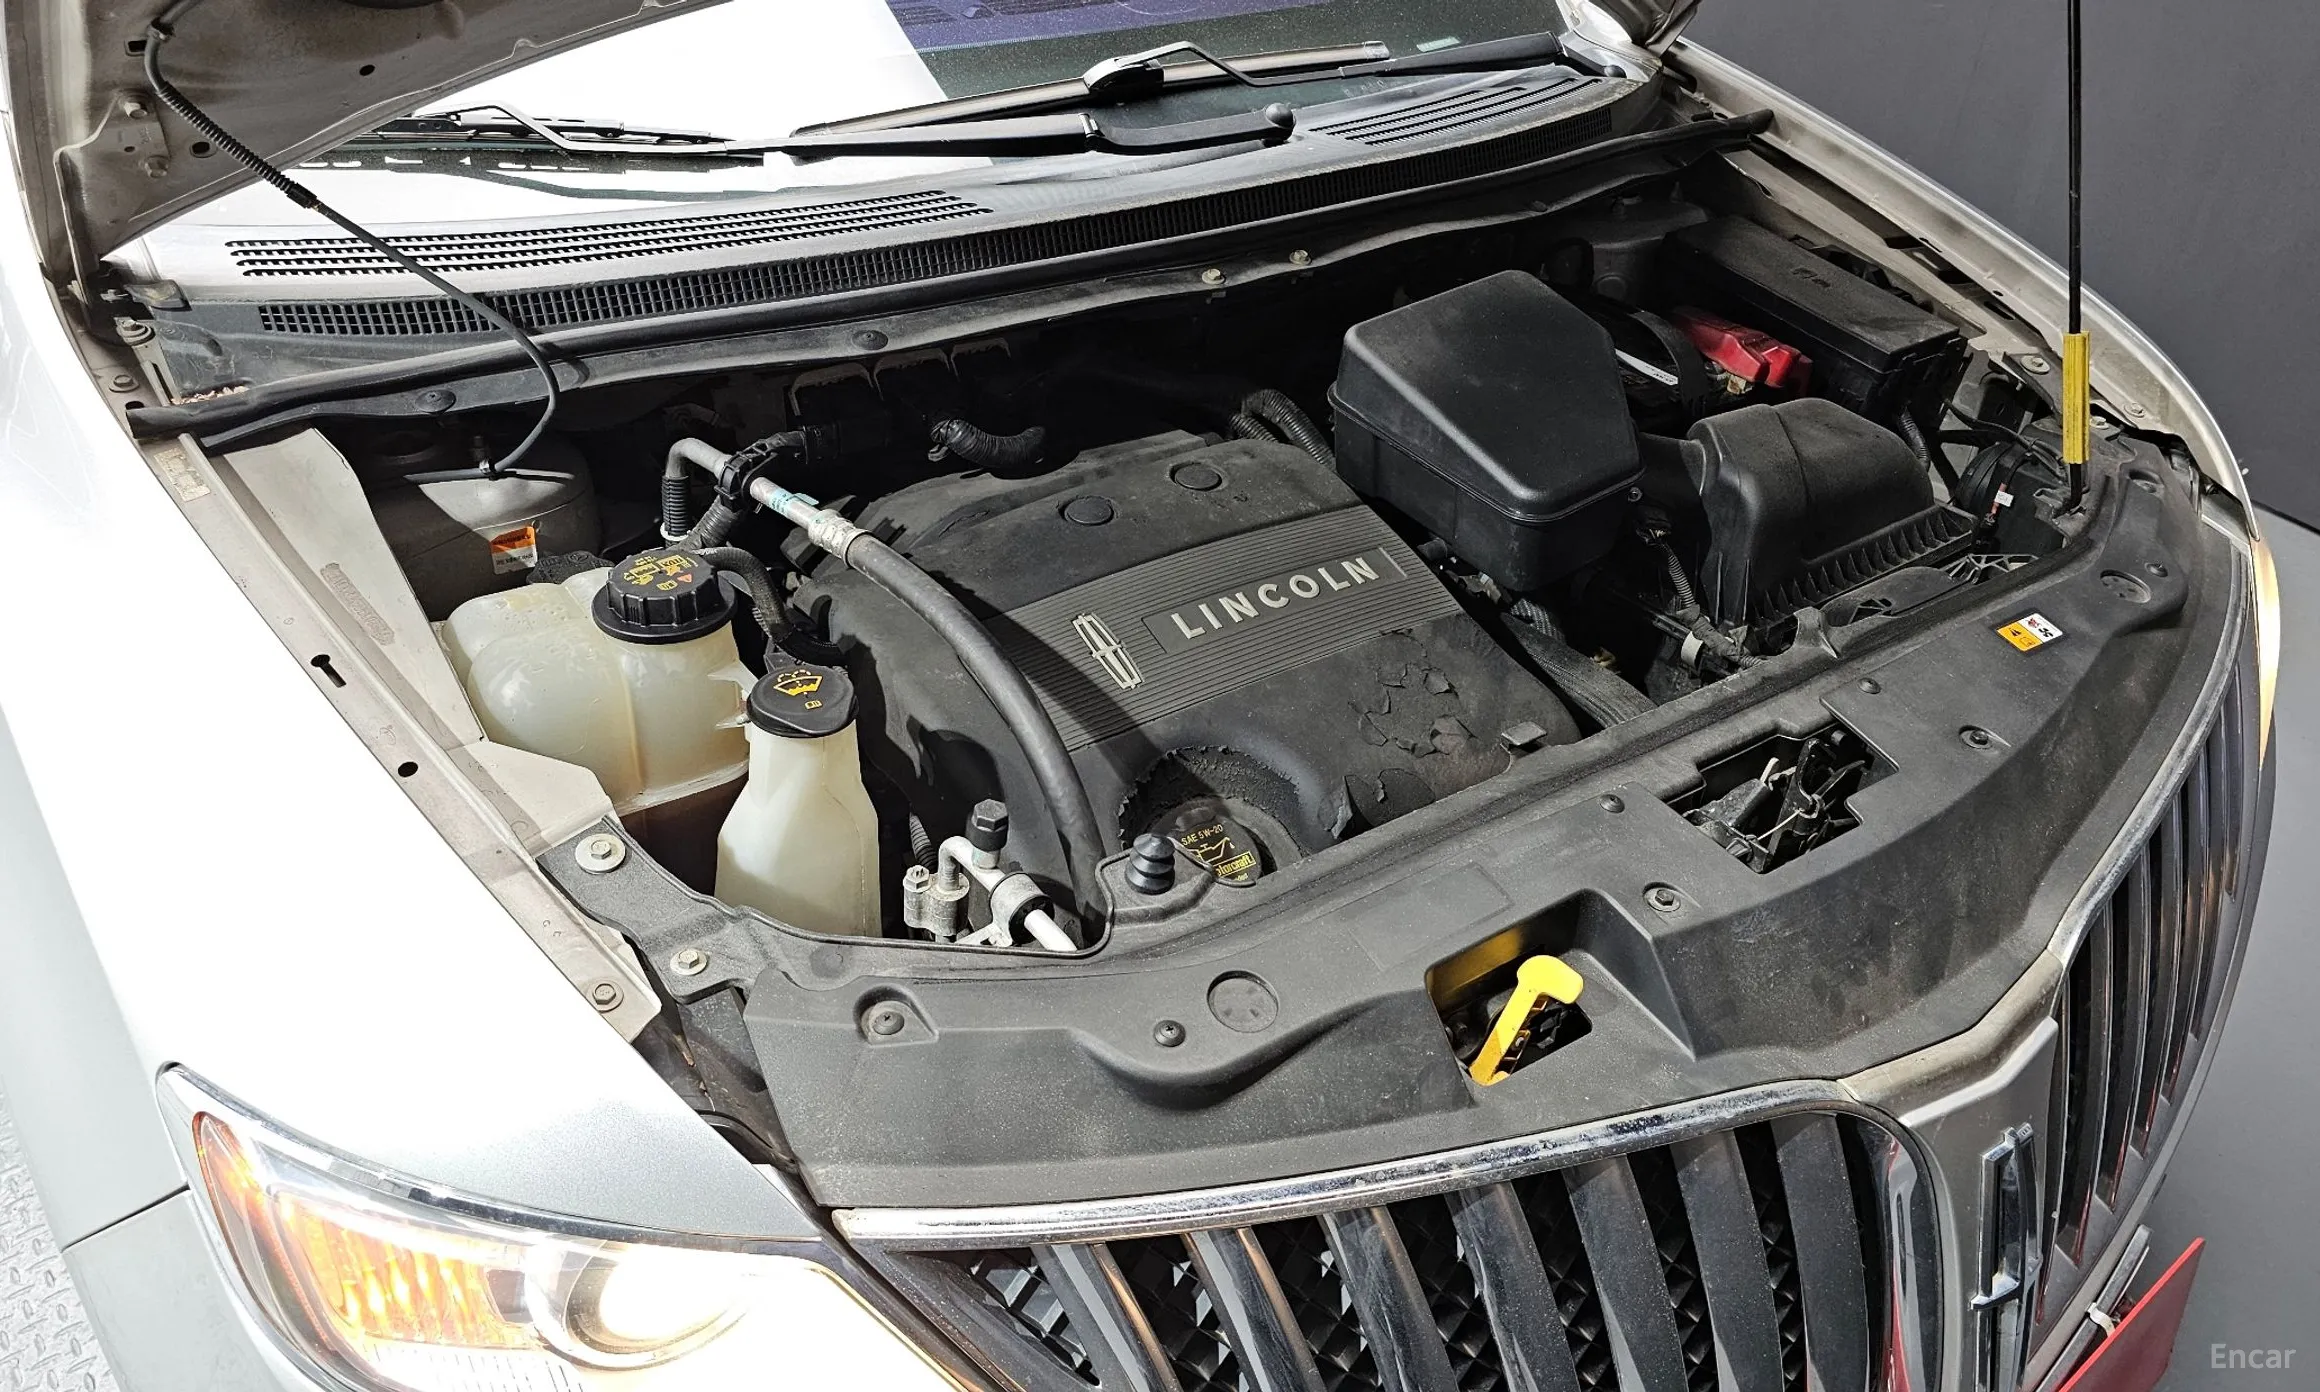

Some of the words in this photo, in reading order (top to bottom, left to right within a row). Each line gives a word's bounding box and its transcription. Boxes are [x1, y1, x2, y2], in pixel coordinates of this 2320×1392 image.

[1170, 556, 1380, 640] LINCOLN
[1181, 833, 1199, 846] SAE
[1197, 824, 1224, 840] 5W-20
[1215, 854, 1253, 877] otorcraft
